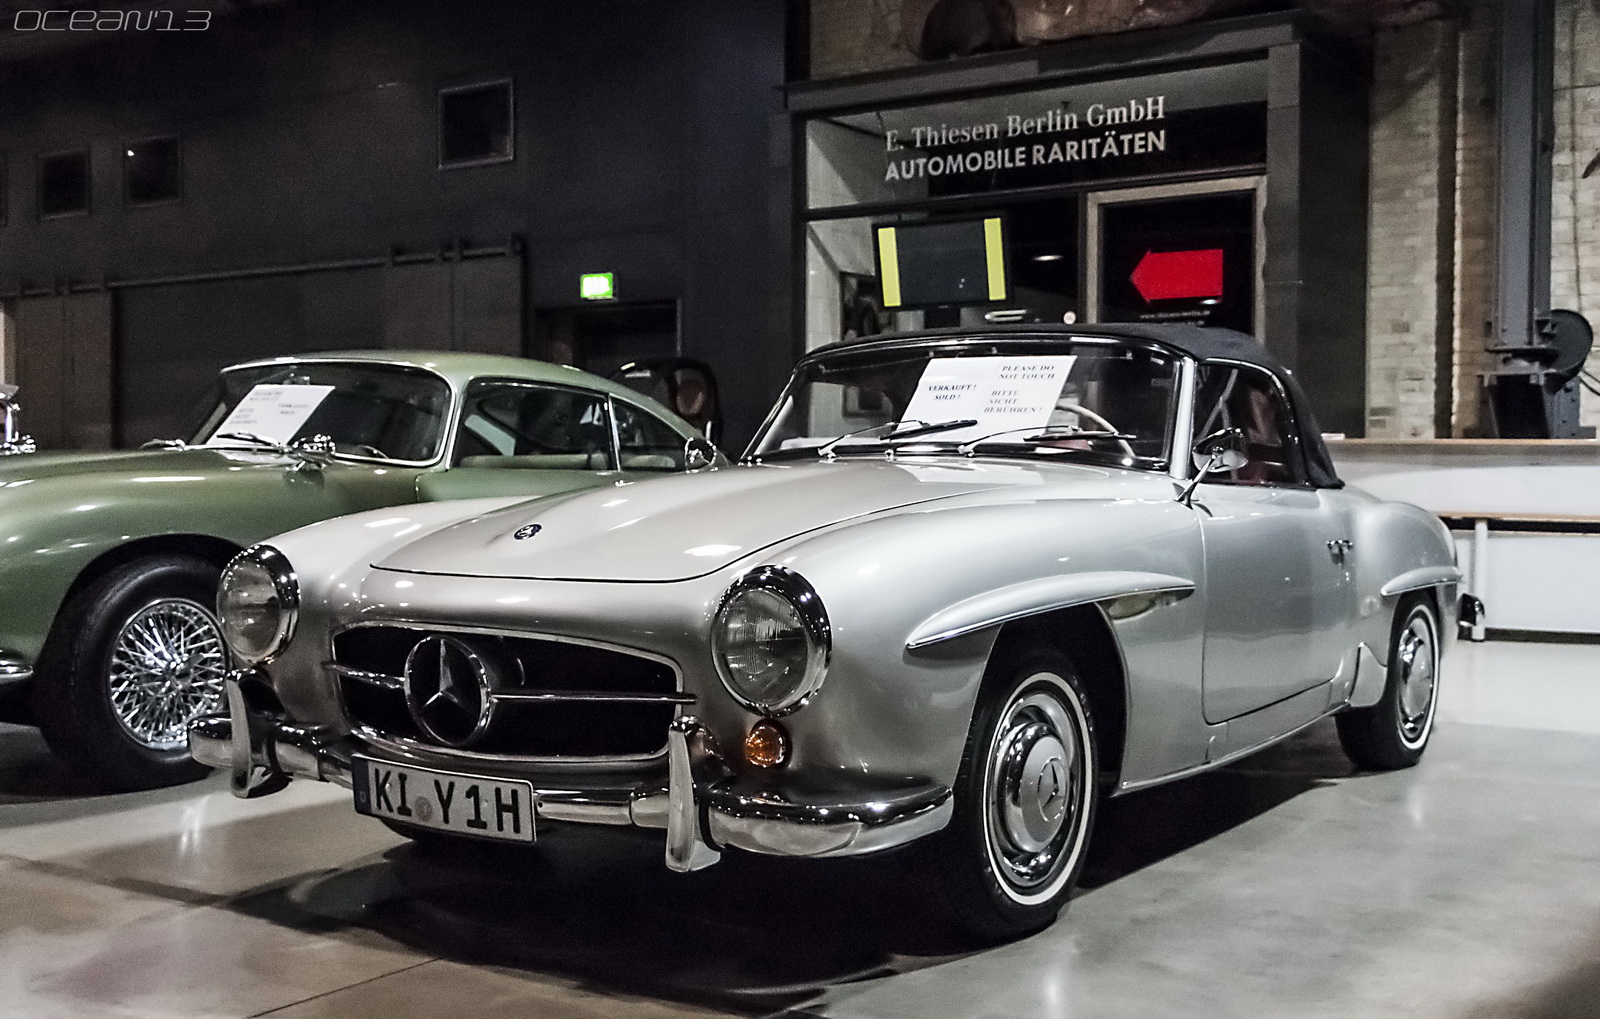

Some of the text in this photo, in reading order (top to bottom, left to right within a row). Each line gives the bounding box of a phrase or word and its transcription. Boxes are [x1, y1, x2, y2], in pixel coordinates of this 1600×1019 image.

[886, 95, 1165, 152] E. Thiesen Berlin GmbH
[884, 129, 1166, 181] AUTOMOBILE RARITÄTEN
[374, 767, 412, 817] KI
